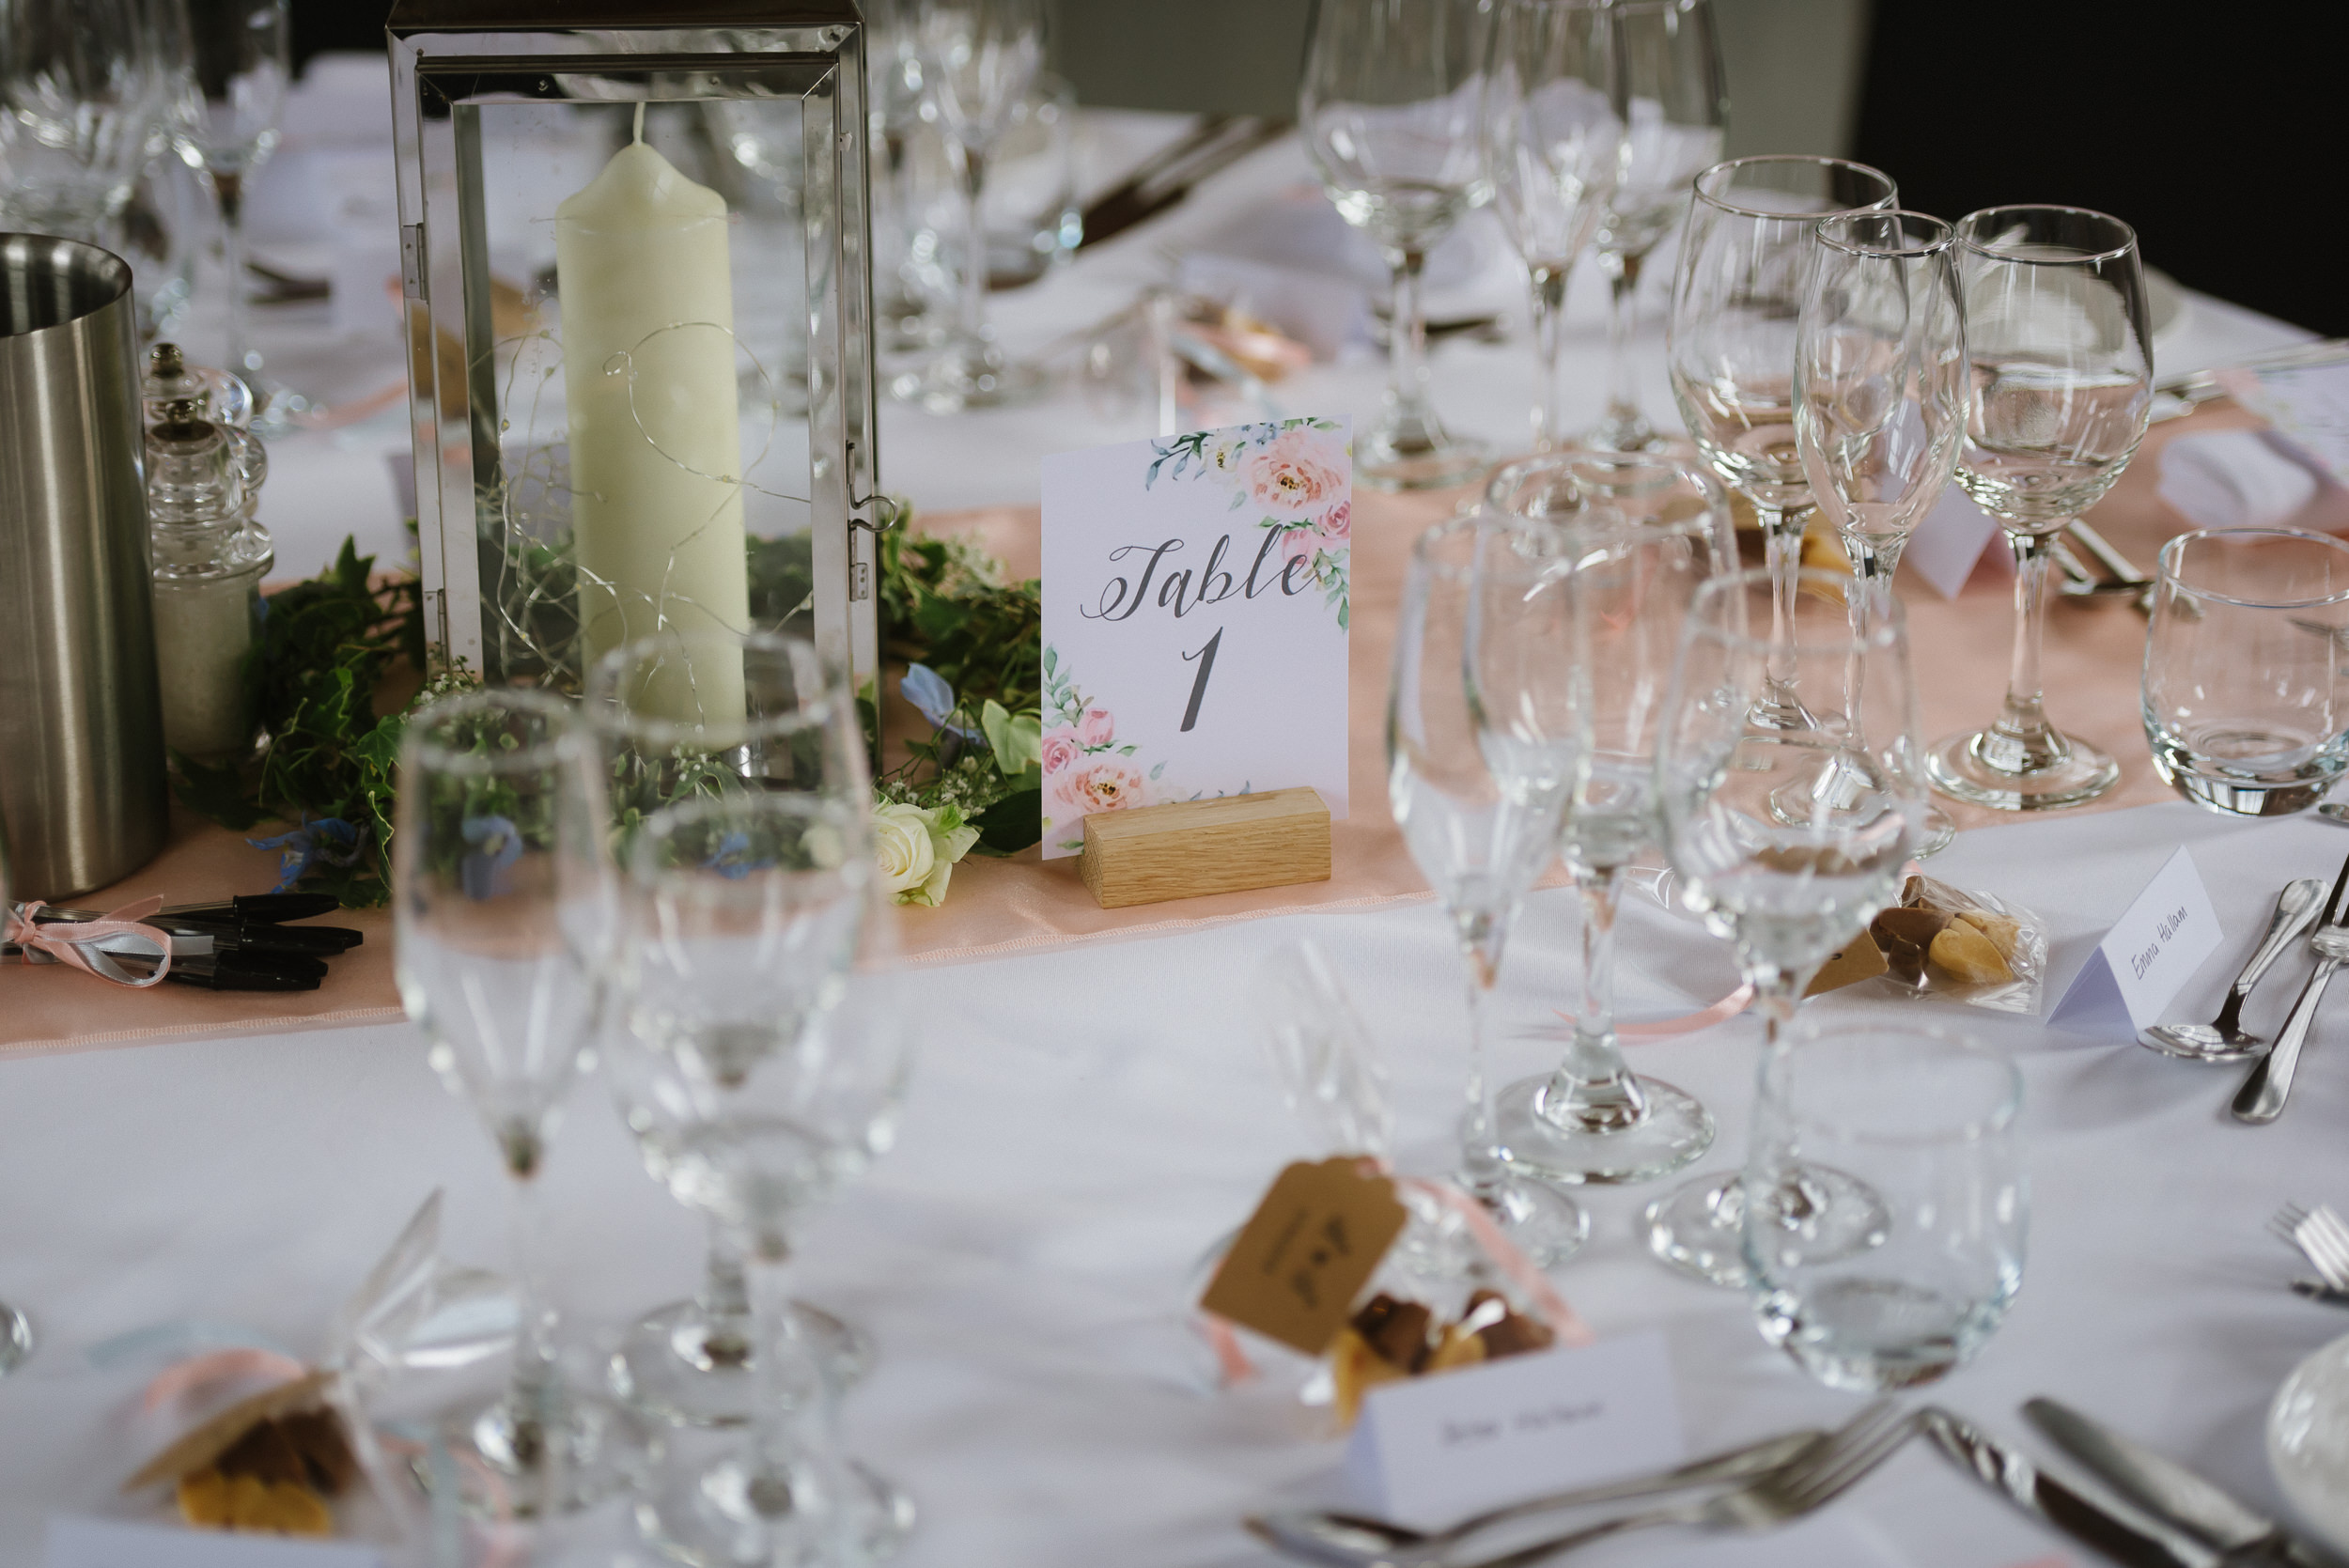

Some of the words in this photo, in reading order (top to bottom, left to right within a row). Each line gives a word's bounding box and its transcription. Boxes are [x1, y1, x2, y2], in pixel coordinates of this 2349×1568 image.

[1080, 523, 1321, 622] Table
[1180, 626, 1223, 733] 1
[2131, 942, 2160, 981] Emma
[2156, 906, 2188, 943] Hallam
